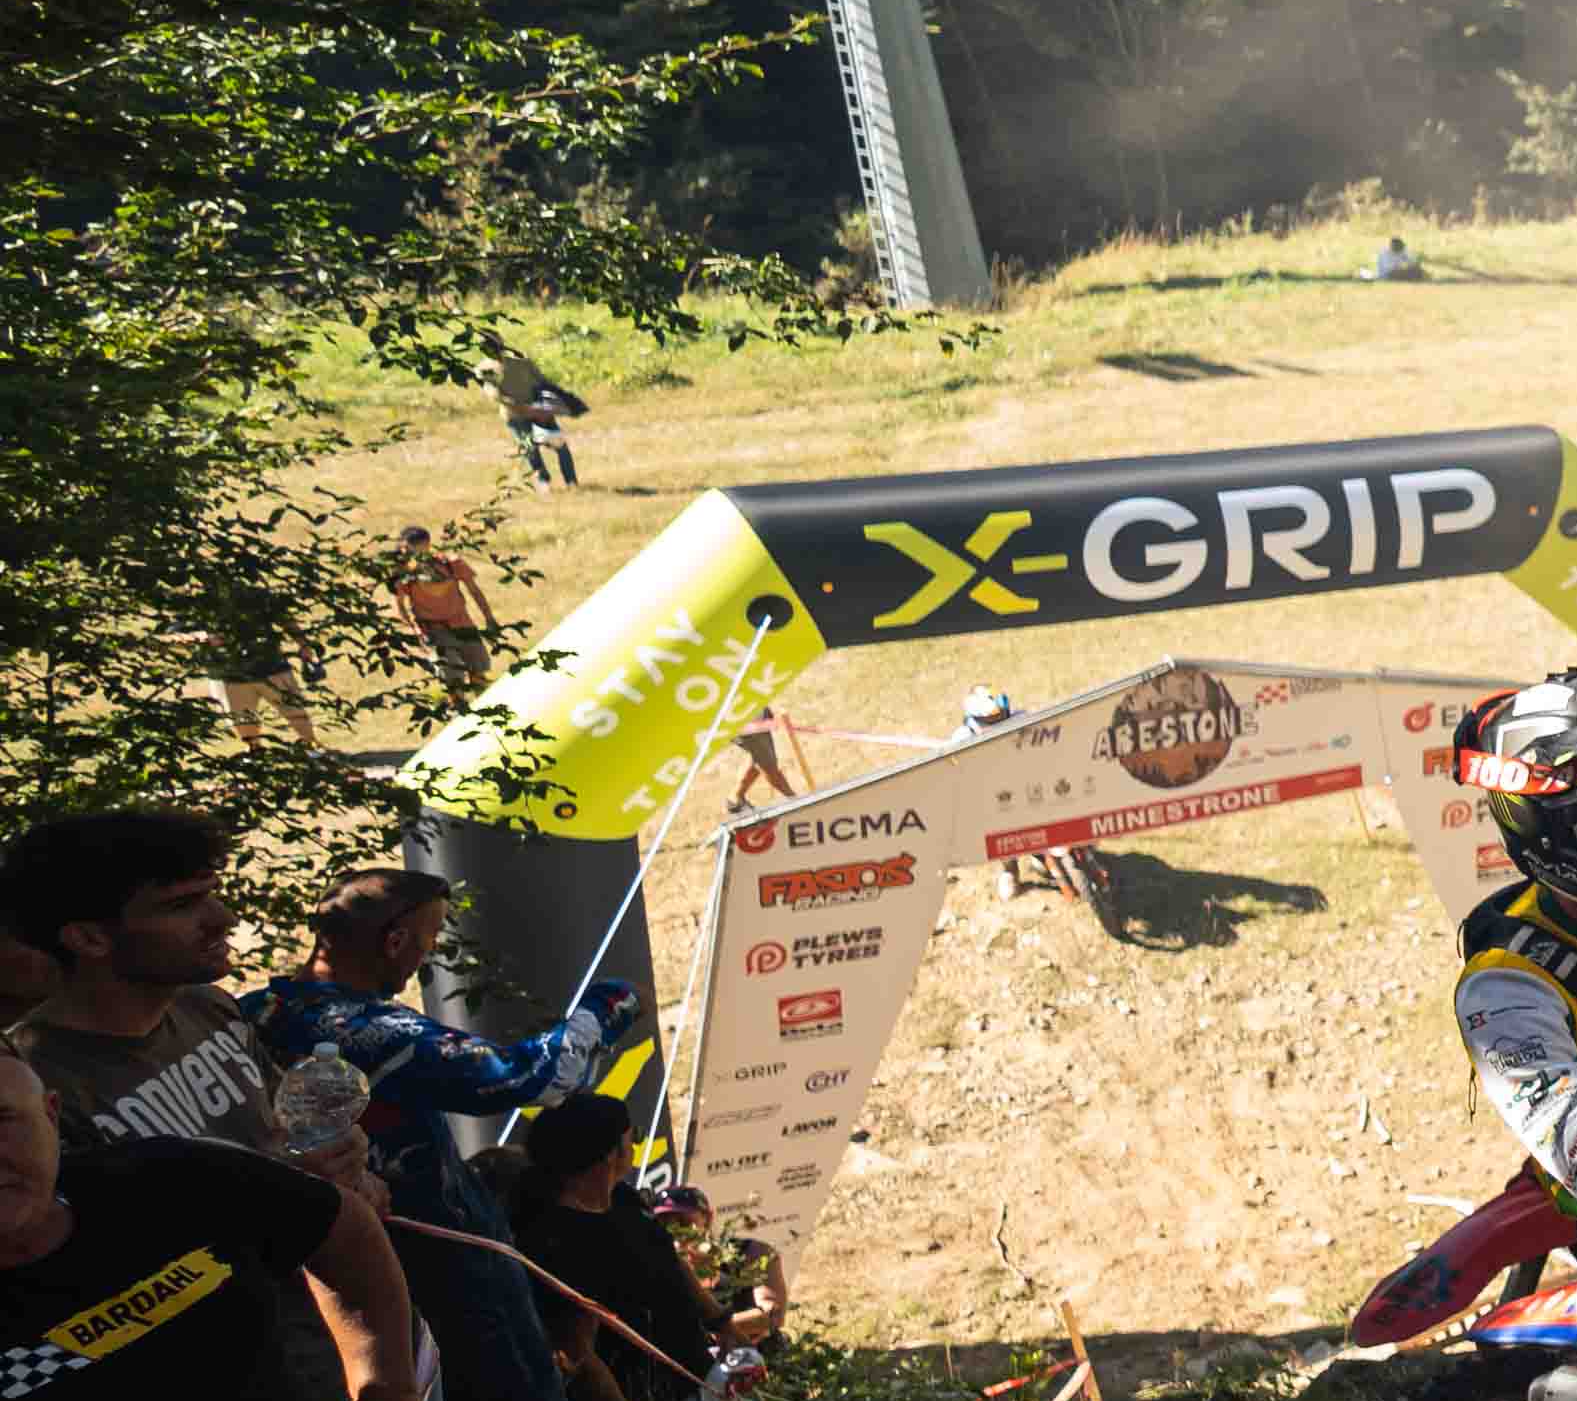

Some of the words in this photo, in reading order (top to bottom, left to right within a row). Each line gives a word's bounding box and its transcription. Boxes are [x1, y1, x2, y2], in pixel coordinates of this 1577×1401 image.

[864, 468, 1496, 629] X-GRIP
[570, 607, 705, 739] STAY
[1091, 704, 1261, 762] ABESTONE
[787, 808, 927, 848] EICMA
[1089, 783, 1282, 840] MINESTRONE
[793, 926, 883, 952] PLEWS
[793, 944, 881, 970] TYRES
[68, 1264, 205, 1348] BARDAHL
